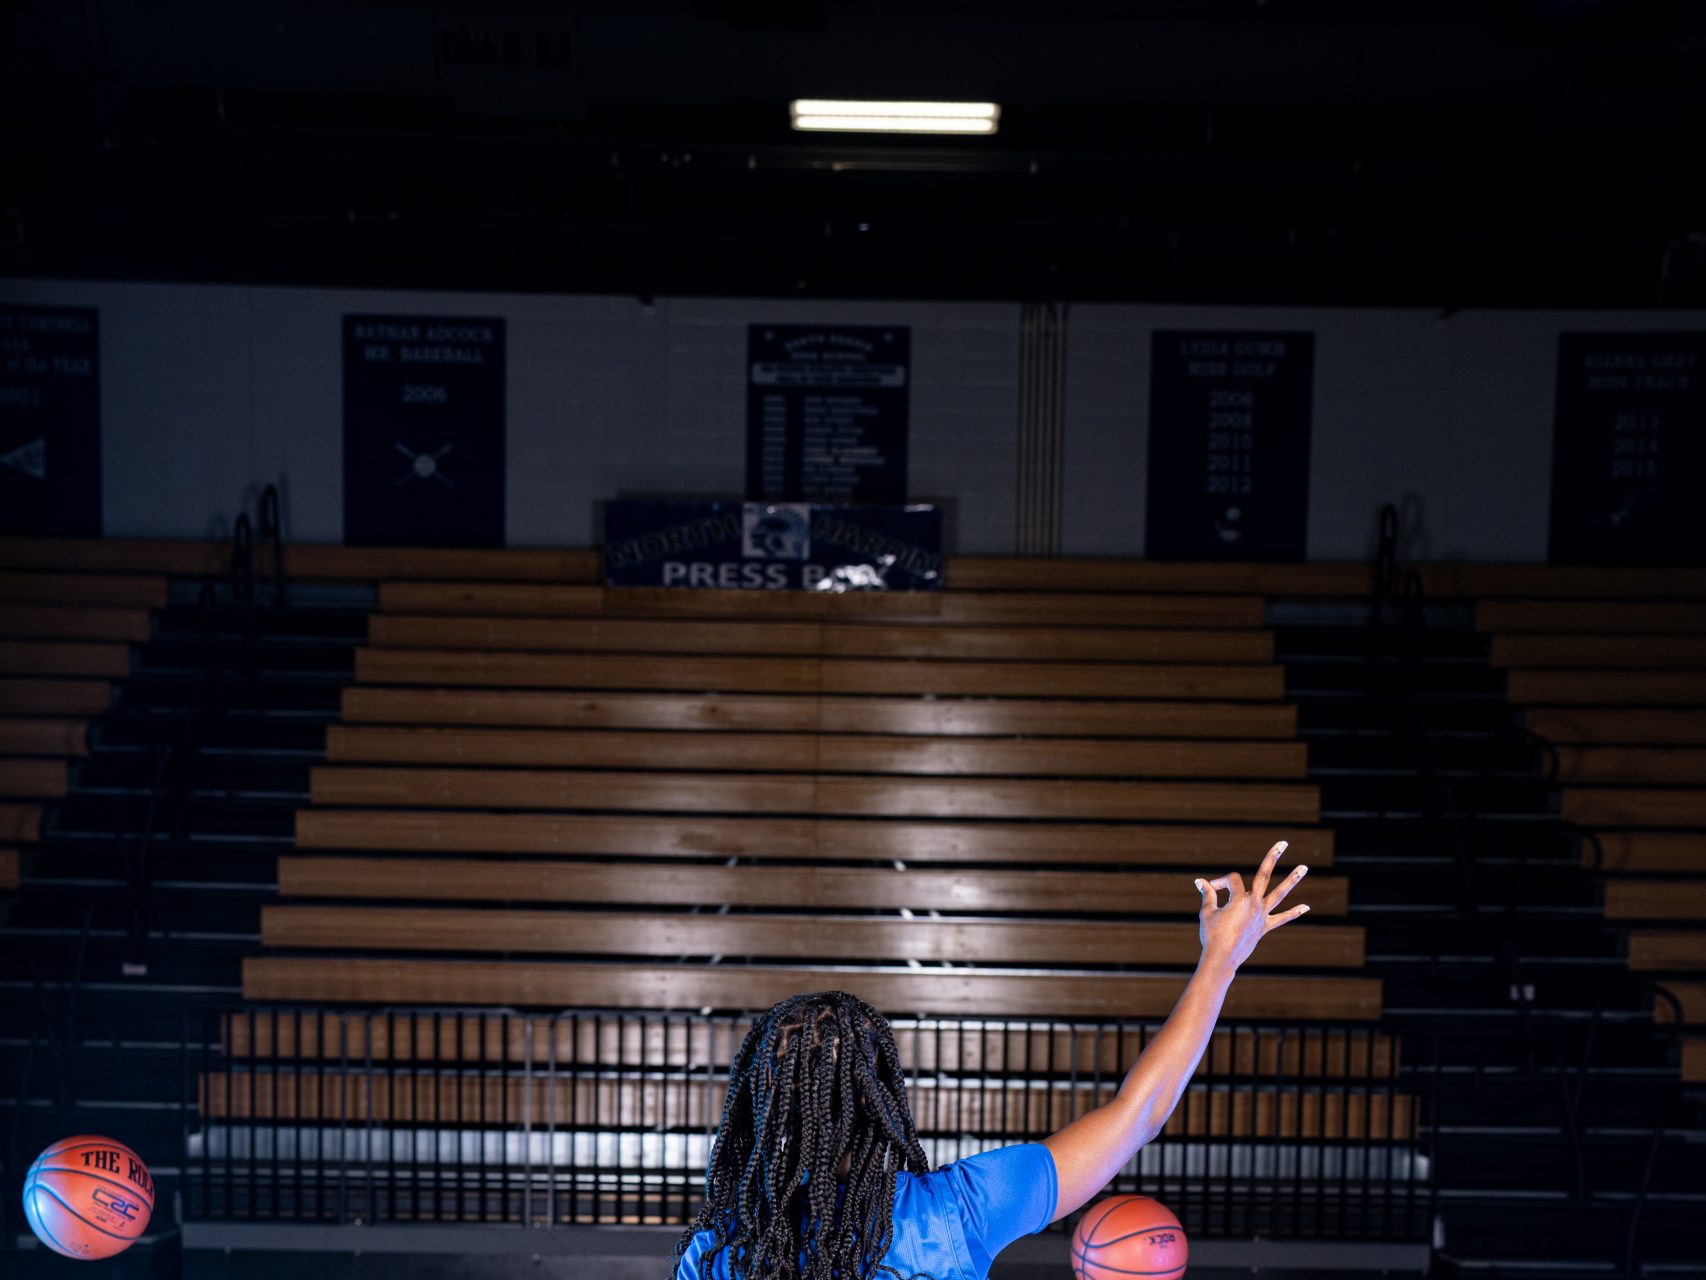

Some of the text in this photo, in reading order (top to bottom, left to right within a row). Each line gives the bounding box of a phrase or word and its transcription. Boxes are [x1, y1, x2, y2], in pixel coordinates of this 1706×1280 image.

[401, 345, 485, 364] BASEBALL
[1231, 360, 1277, 377] GOLF
[661, 561, 790, 589] PRESS
[80, 1150, 121, 1174] THE
